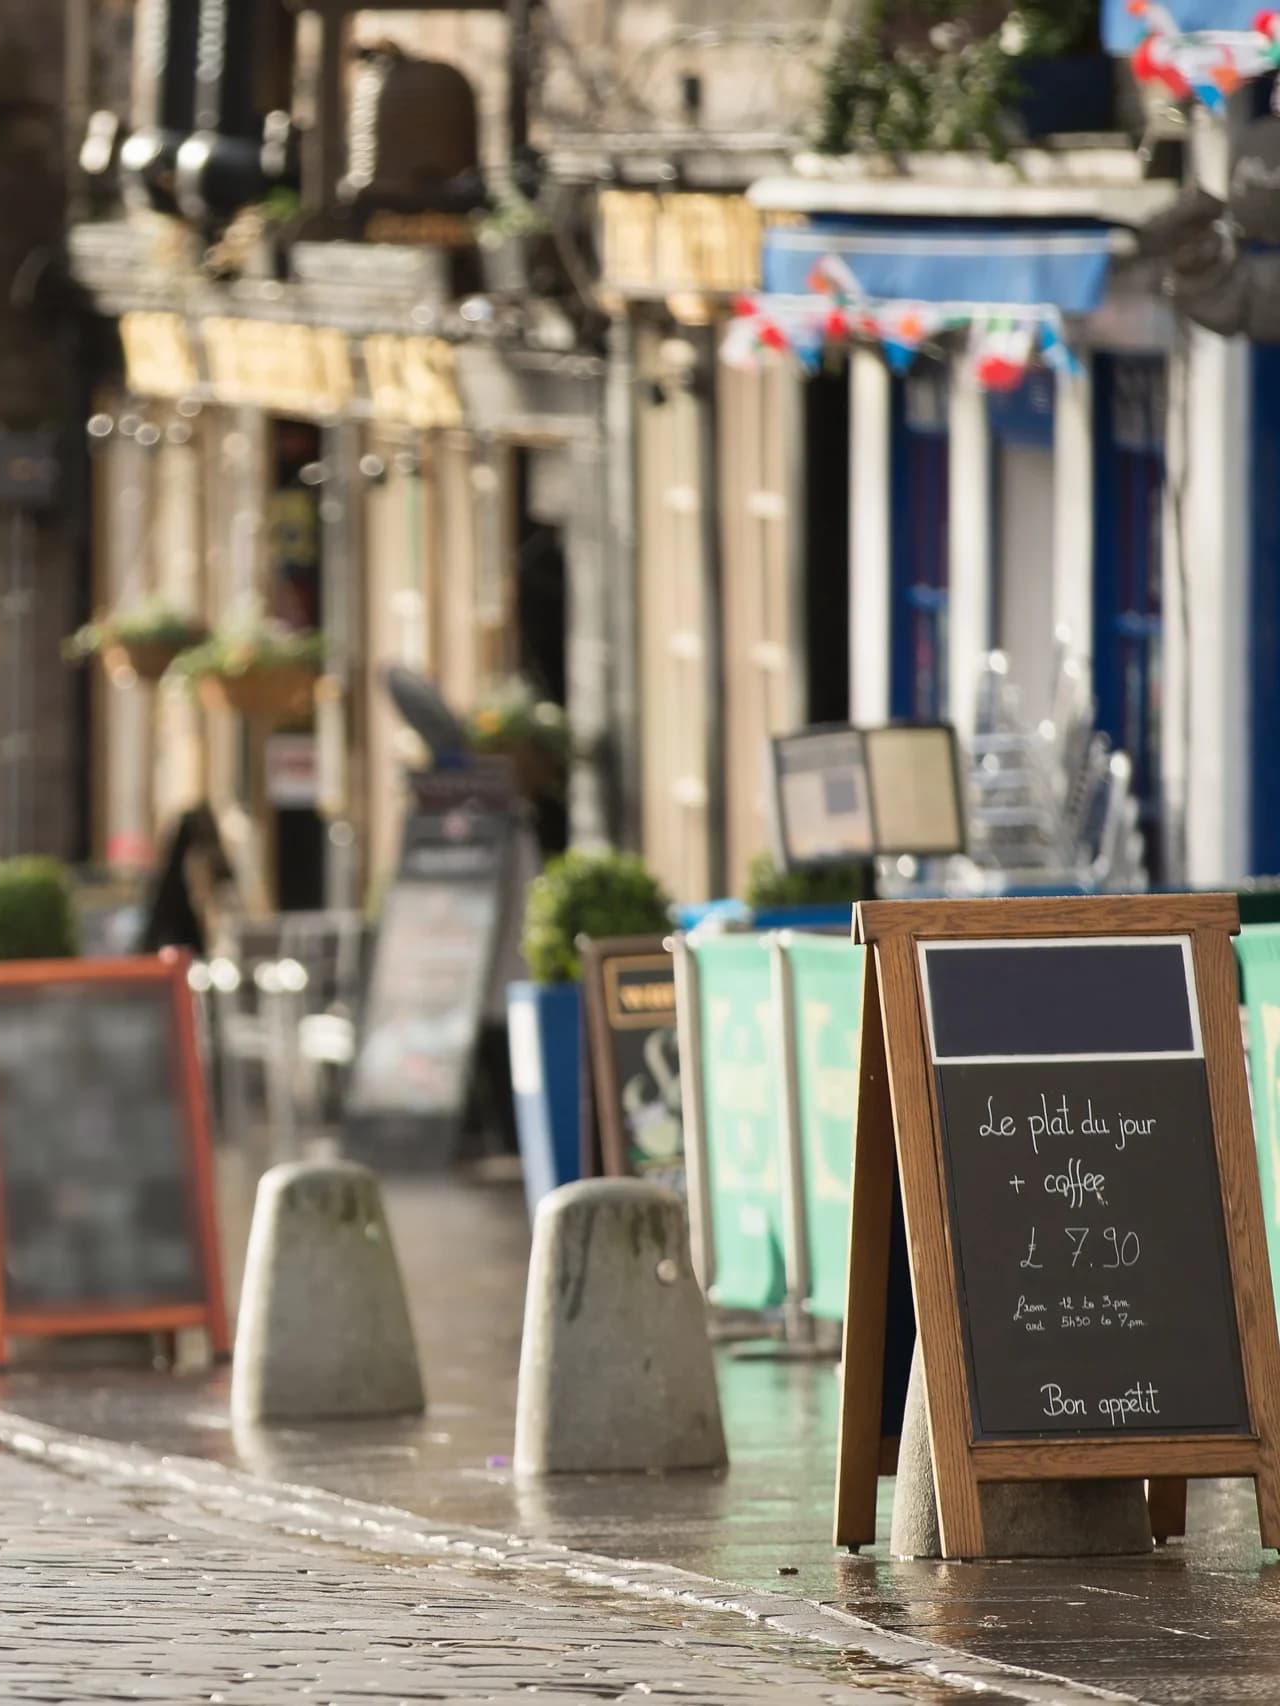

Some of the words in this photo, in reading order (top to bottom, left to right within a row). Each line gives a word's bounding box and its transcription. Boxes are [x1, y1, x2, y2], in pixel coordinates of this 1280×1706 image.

[979, 1095, 1016, 1136] Le
[1027, 1093, 1074, 1154] plat
[1081, 1098, 1110, 1134] du
[1115, 1112, 1157, 1150] jour
[1009, 1175, 1025, 1194] +
[1044, 1158, 1105, 1208] coffee
[1020, 1226, 1043, 1268] £
[1065, 1226, 1140, 1268] 7.90
[1059, 1296, 1074, 1310] 12
[1082, 1296, 1094, 1309] to
[1025, 1320, 1045, 1331] and
[1061, 1315, 1090, 1328] 5h30
[1101, 1314, 1112, 1325] to
[1040, 1383, 1087, 1416] Bon
